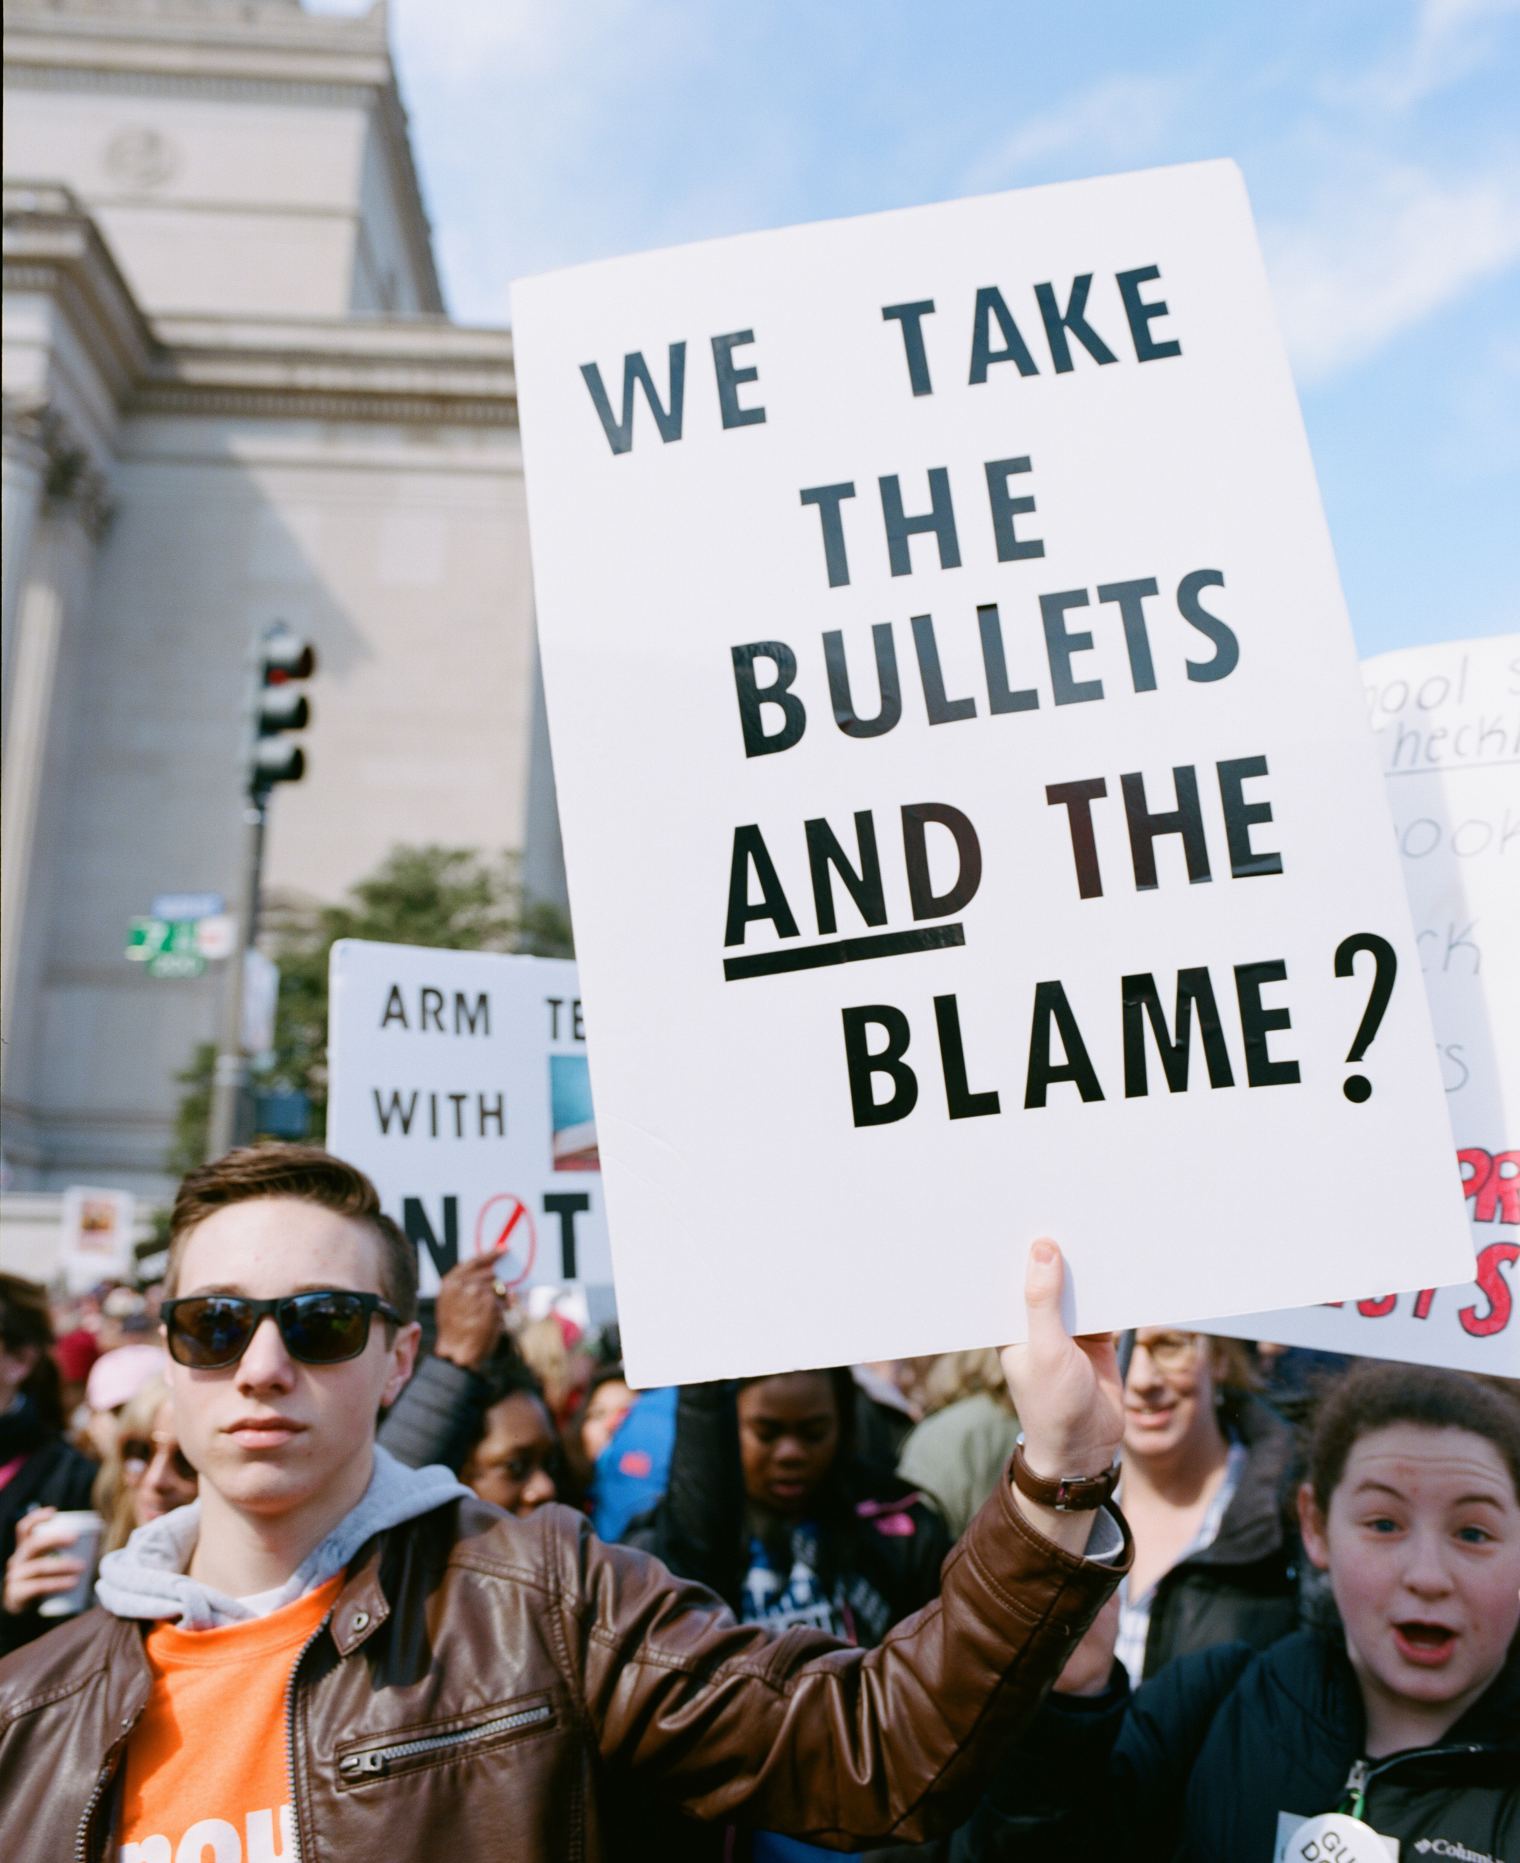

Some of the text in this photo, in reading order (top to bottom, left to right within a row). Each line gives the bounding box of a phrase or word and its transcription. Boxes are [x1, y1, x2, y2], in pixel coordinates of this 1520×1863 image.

[580, 265, 1182, 455] WE TAKE
[800, 456, 1045, 588] THE
[731, 570, 1240, 759] BULLETS
[724, 755, 1284, 947] AND THE
[381, 983, 491, 1036] ARM
[373, 1089, 506, 1138] WITH
